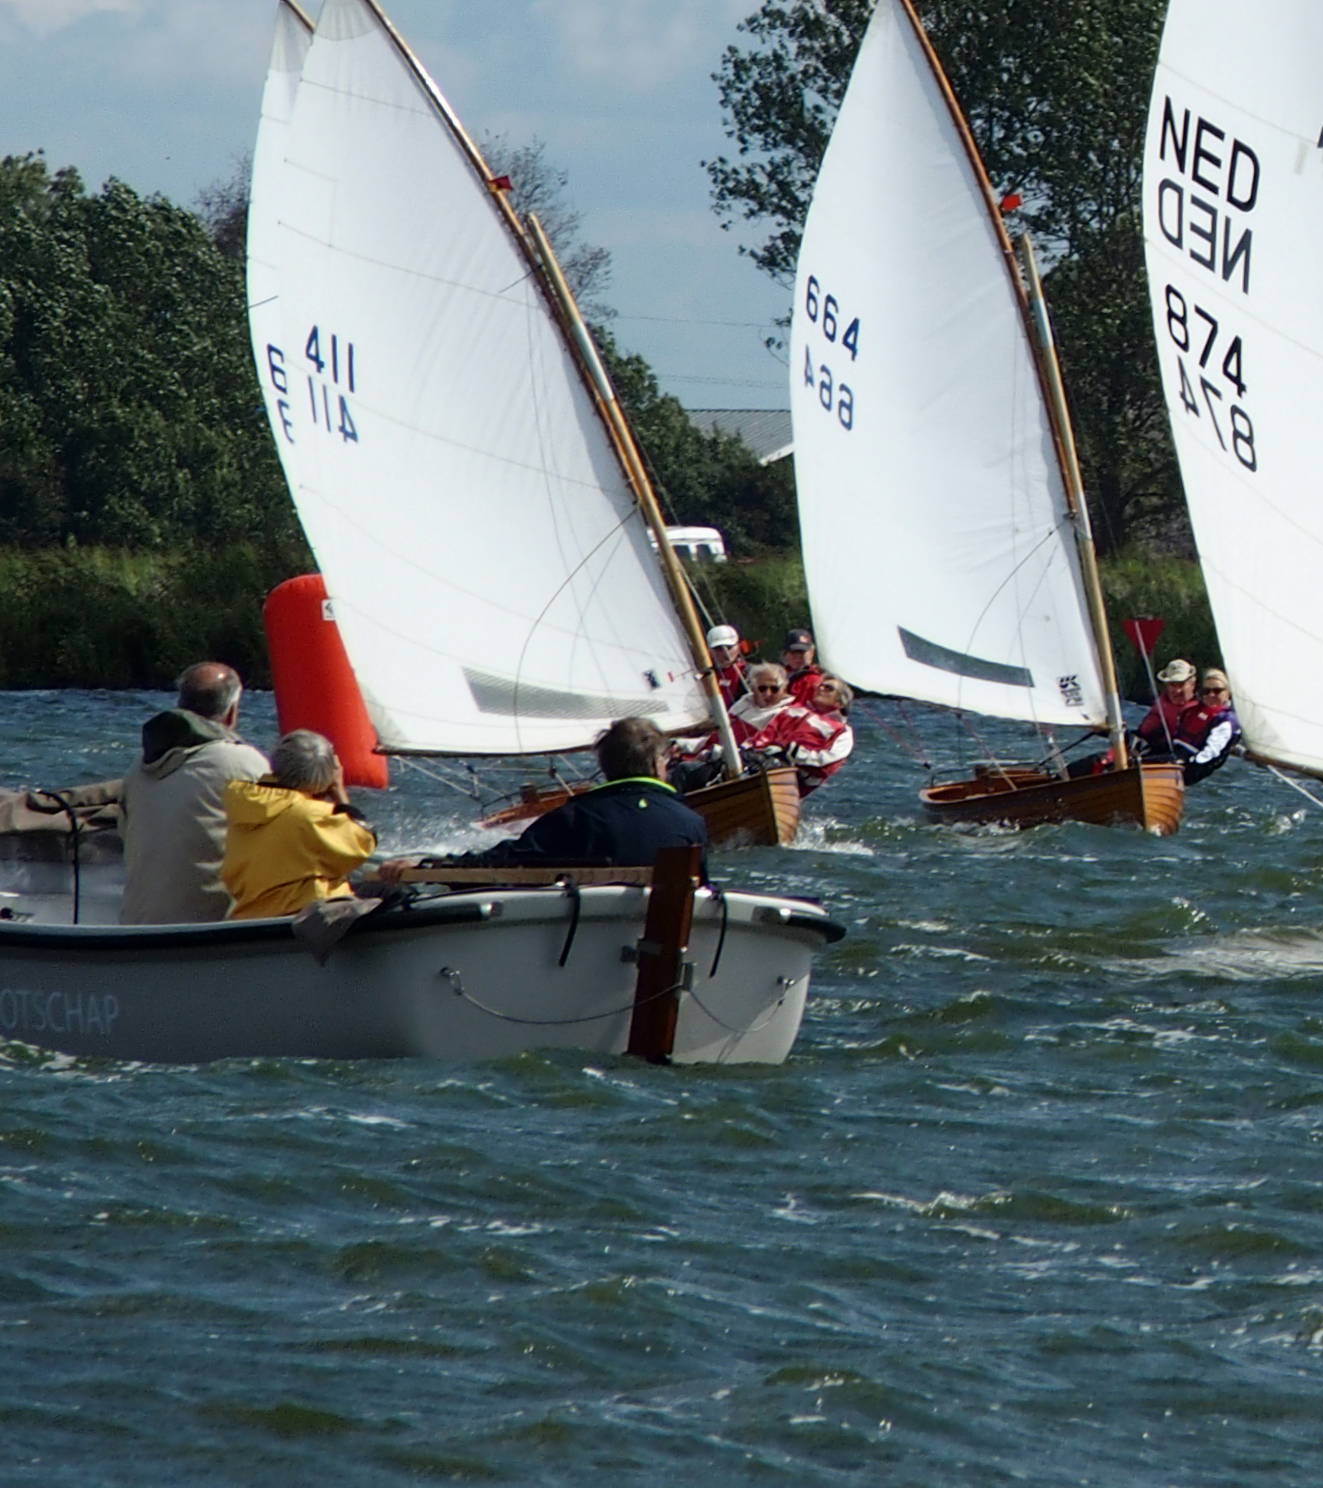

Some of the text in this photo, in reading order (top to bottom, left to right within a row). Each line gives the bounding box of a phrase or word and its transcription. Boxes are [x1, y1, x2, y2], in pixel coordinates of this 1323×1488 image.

[1160, 96, 1260, 213] NED
[306, 326, 354, 393] 411
[806, 275, 859, 362] 664
[1165, 284, 1247, 398] 874
